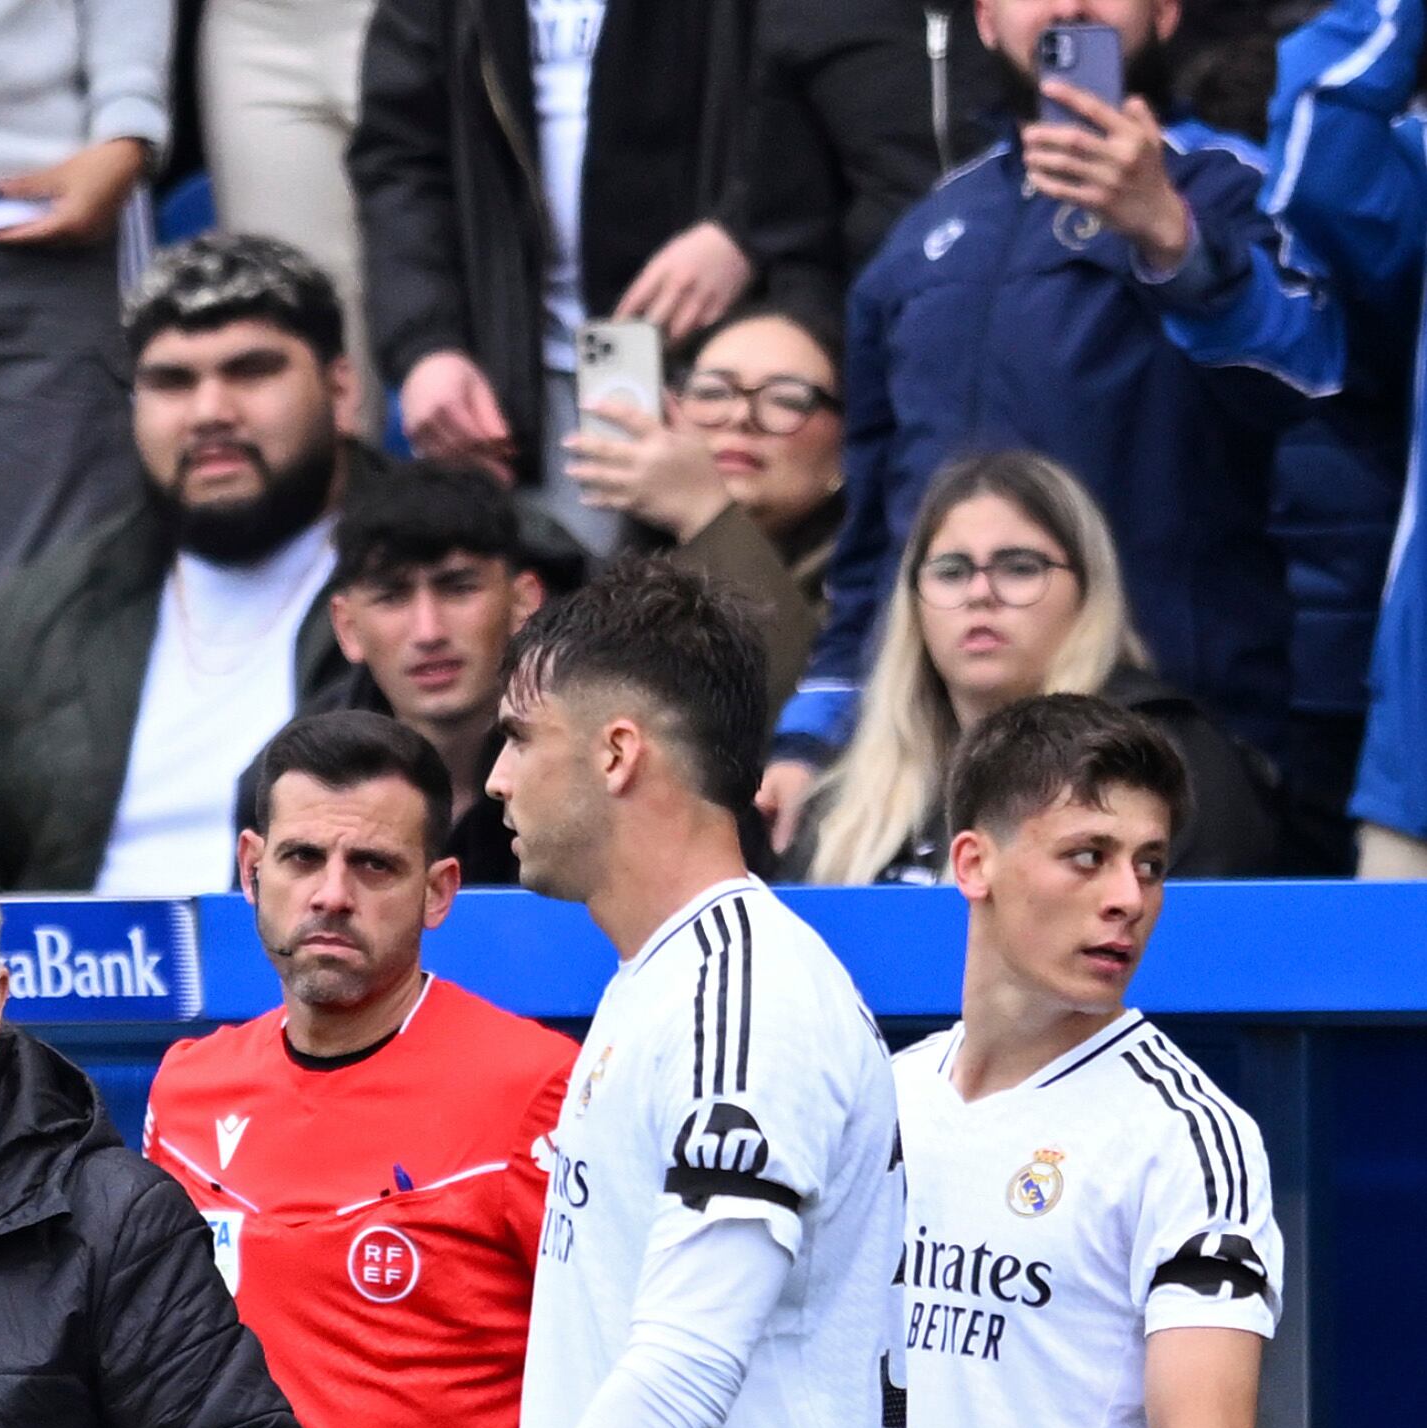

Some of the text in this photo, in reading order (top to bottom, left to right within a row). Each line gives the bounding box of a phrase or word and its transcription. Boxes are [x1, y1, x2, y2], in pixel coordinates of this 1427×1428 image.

[0, 927, 169, 999] aBank
[902, 1225, 1052, 1309] irates
[905, 1302, 1006, 1362] BETTER
